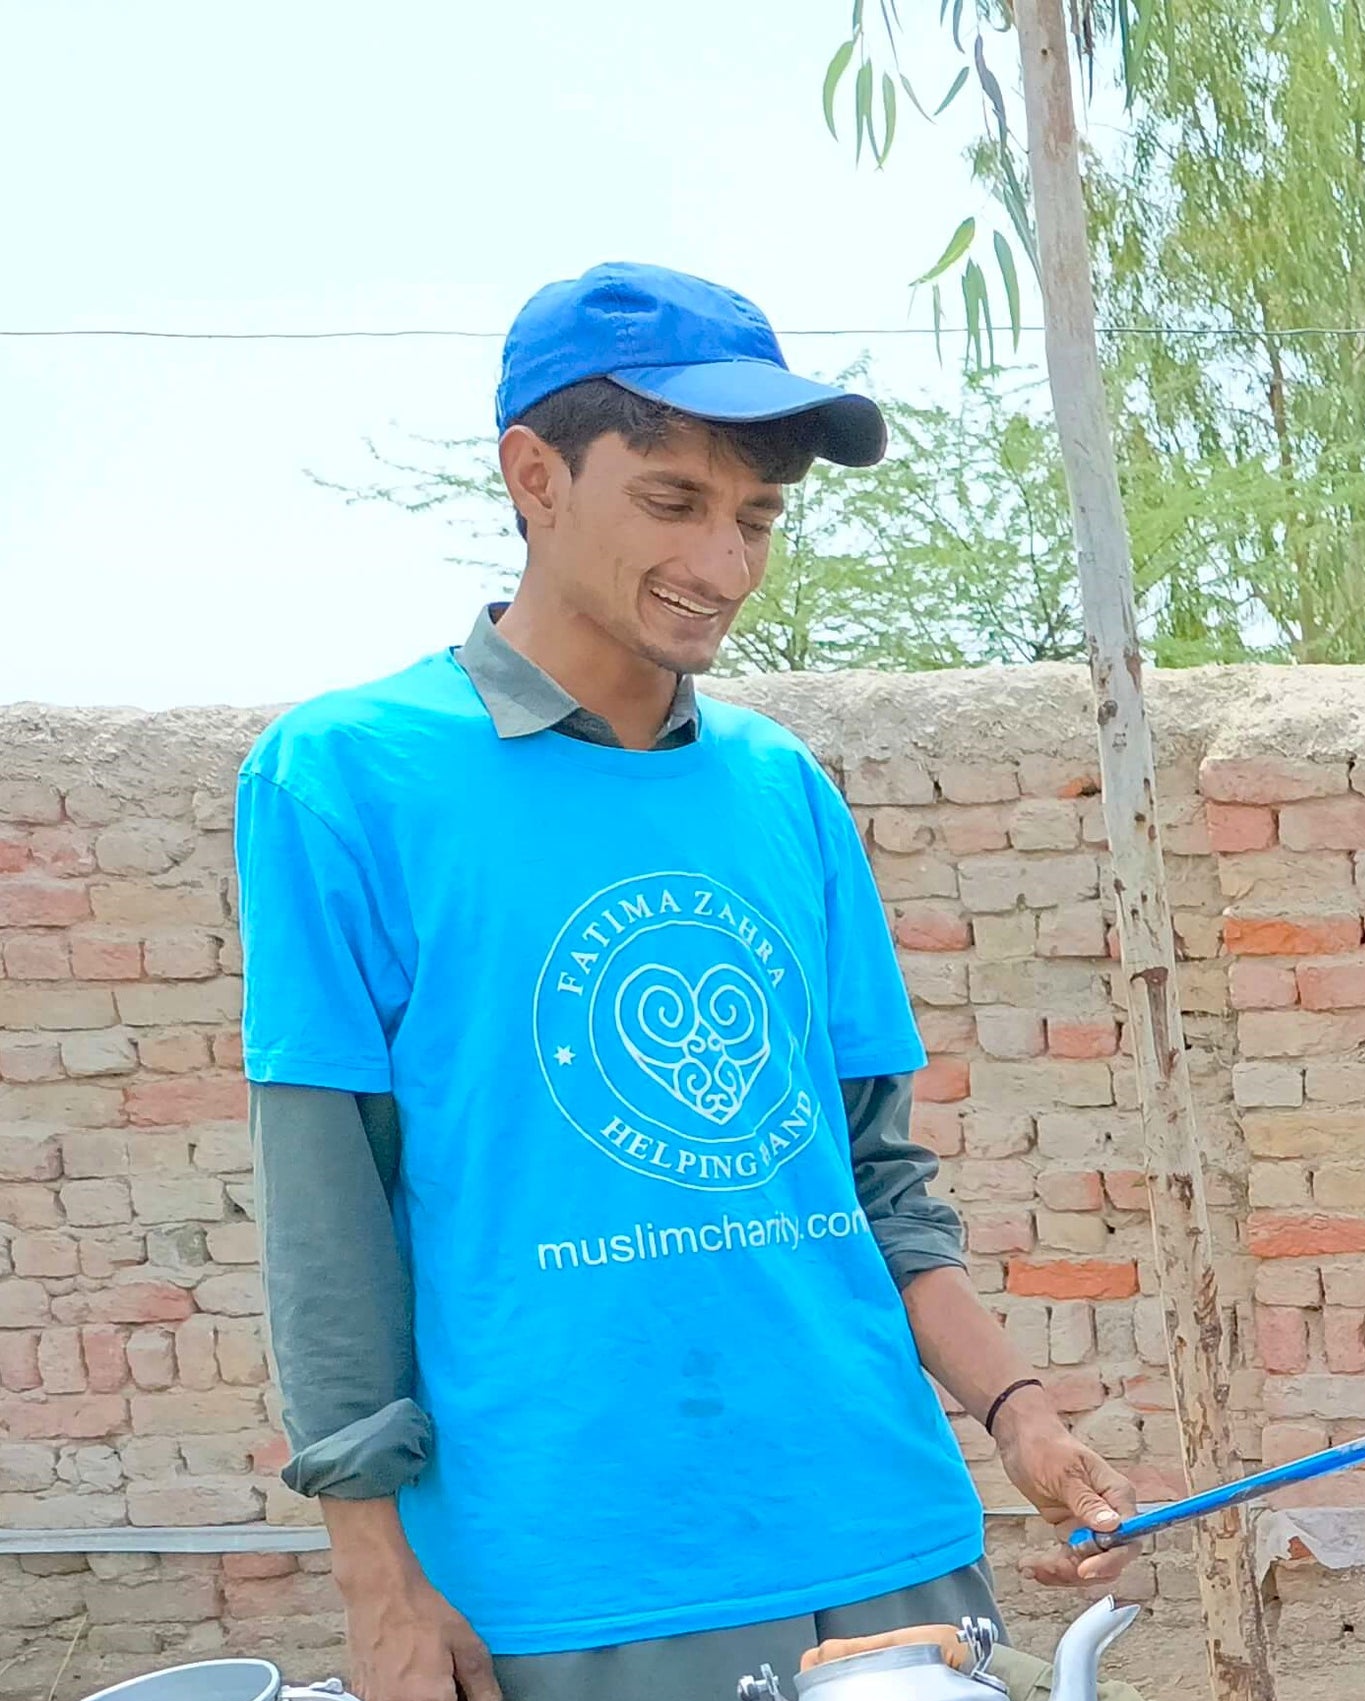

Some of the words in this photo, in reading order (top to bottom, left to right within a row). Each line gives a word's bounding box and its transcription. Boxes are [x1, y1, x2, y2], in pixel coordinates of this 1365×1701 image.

[557, 889, 682, 997] FATIMA
[694, 890, 785, 988] ZAHRA
[600, 1115, 758, 1179] HELPING
